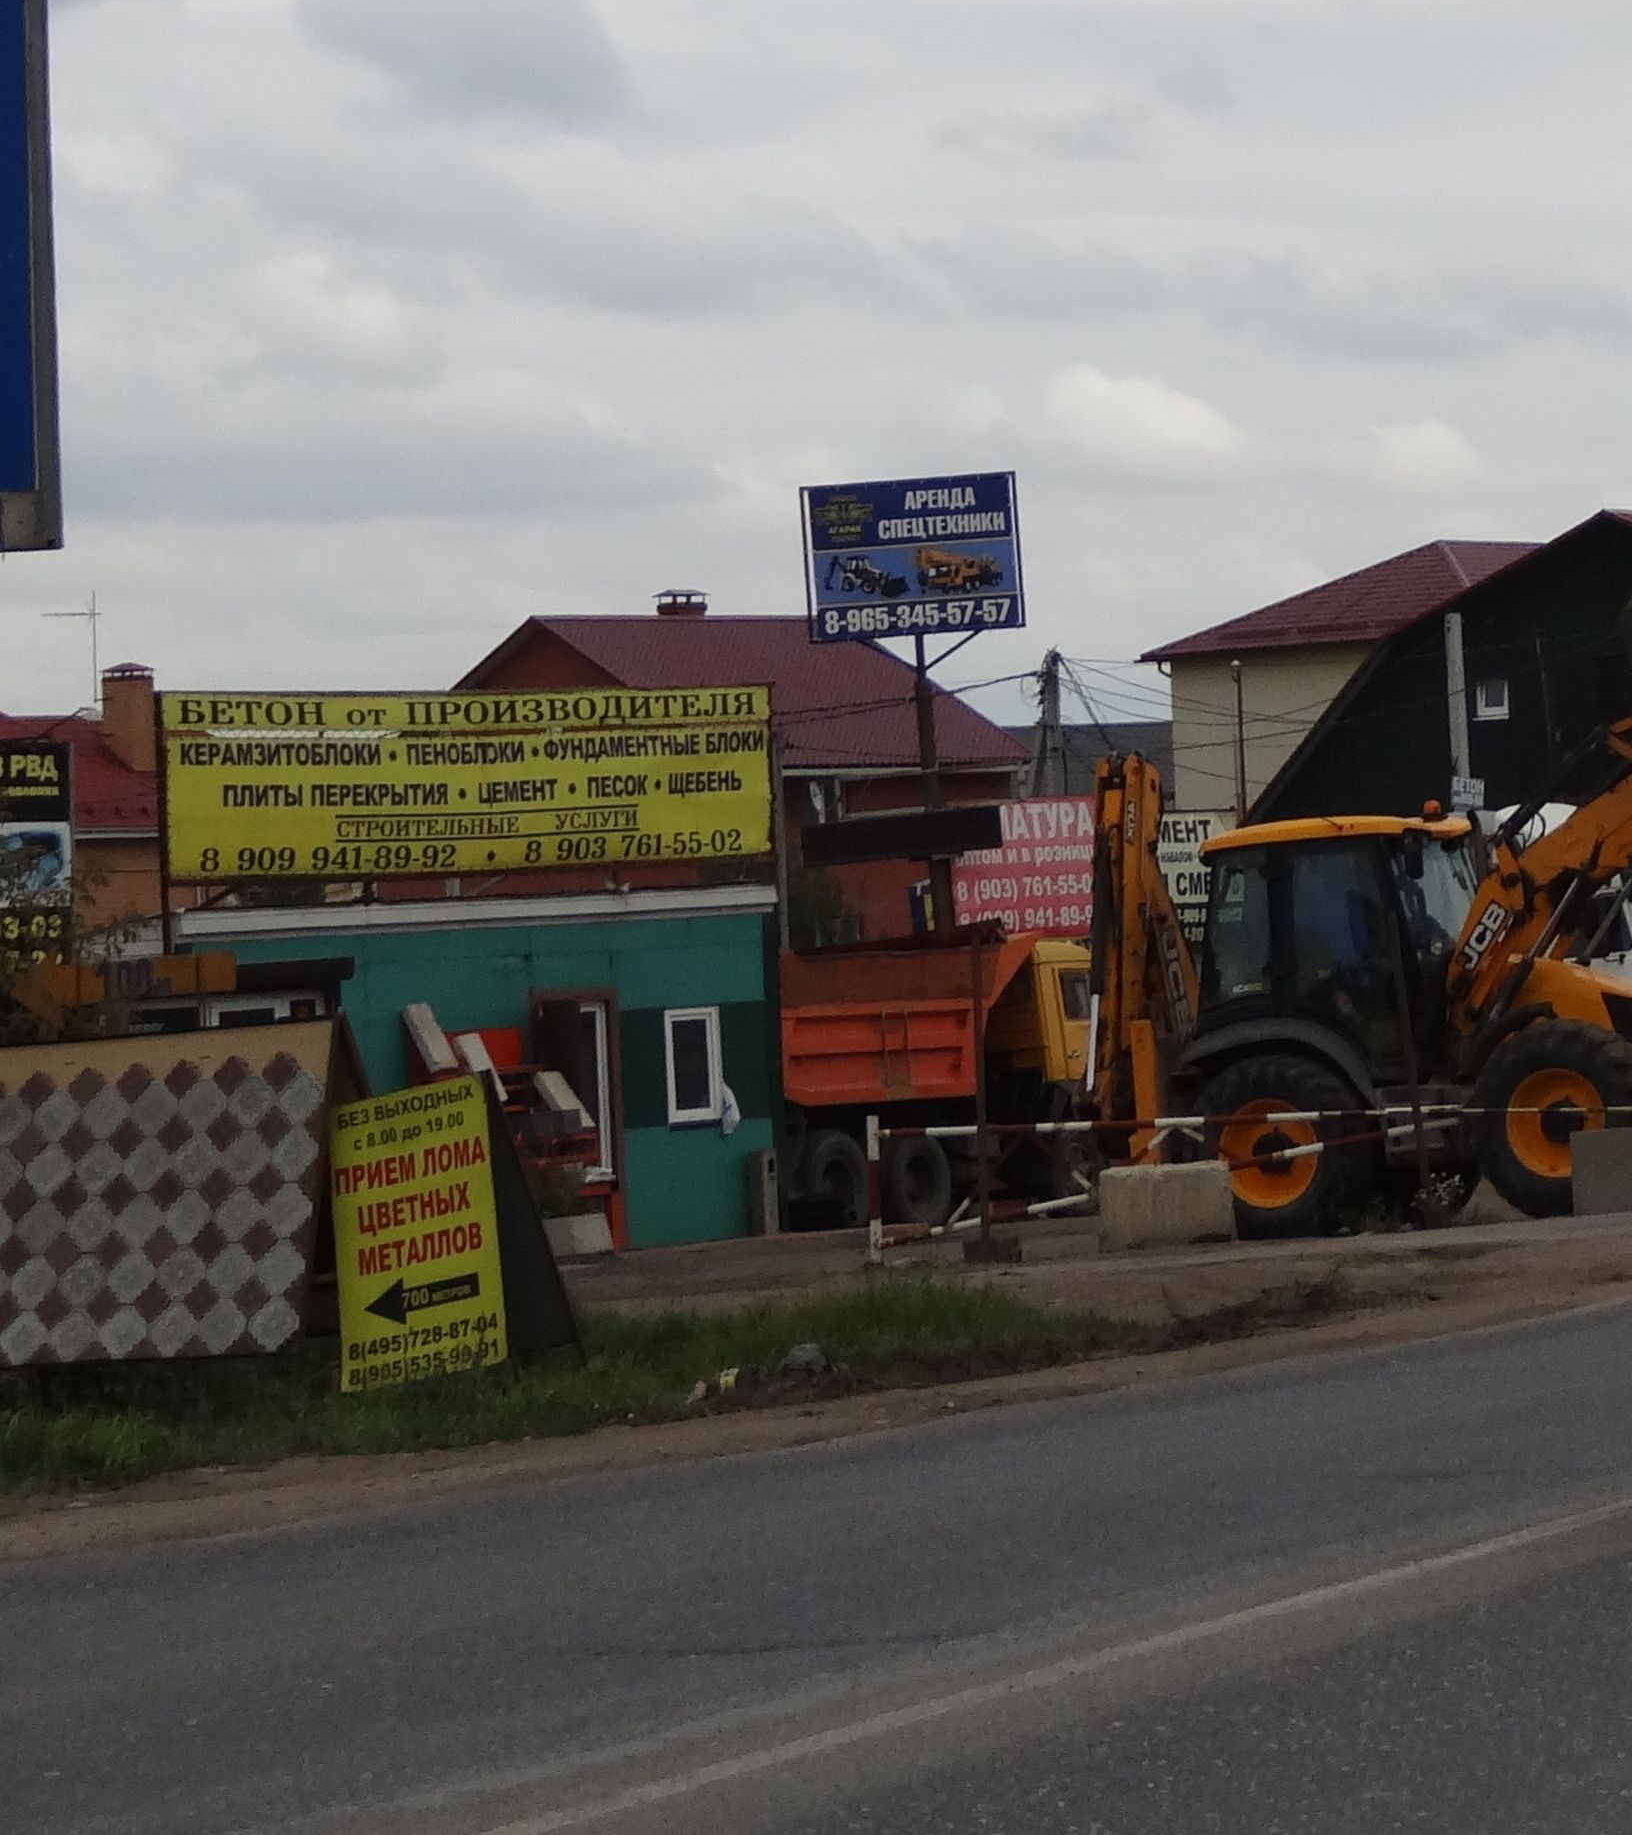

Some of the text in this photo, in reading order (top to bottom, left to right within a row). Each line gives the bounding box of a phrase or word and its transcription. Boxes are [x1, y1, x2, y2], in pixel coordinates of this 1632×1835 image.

[905, 486, 976, 511] АРЕНДА
[878, 512, 1005, 539] СПЕЦТЕХНИКИ
[825, 598, 1011, 635] 8-965-345-57-57
[178, 692, 757, 726] БЕТОН от ПРОИЗВОДИТЕЛЯ
[180, 730, 764, 766] КЕРАМЗИТОБЛОКИ ПЕНОБЛОКИ ФУНДАМЕНТНЫЕ БЛОКИ
[11, 755, 59, 782] РВД
[222, 770, 743, 808] ПЛИТЫ ПЕРЕКРЫТИЯ ЦЕМЕНТ ПЕСОК ЩЕБЕНЬ
[336, 808, 639, 838] СТРОИТЕЛЬНЫЕ УСЛУГИ
[200, 844, 457, 872] 8 909 941-89-92
[524, 828, 743, 863] 8 903 761-55-02
[1035, 845, 1093, 867] розниц
[957, 881, 968, 902] 8
[974, 878, 1018, 904] (903)
[1463, 903, 1507, 970] JCB
[338, 1083, 474, 1130] БЕЗ ВЫХОДНЫХ
[353, 1111, 464, 1151] с 8.00 до 19.00
[335, 1135, 486, 1197] ПРИЕМ ЛОМА
[357, 1181, 471, 1237] ЦВЕТНЫХ
[358, 1221, 482, 1277] МЕТАЛЛОВ
[401, 1287, 430, 1310] 700
[349, 1311, 498, 1364] 8(495)728-87-04
